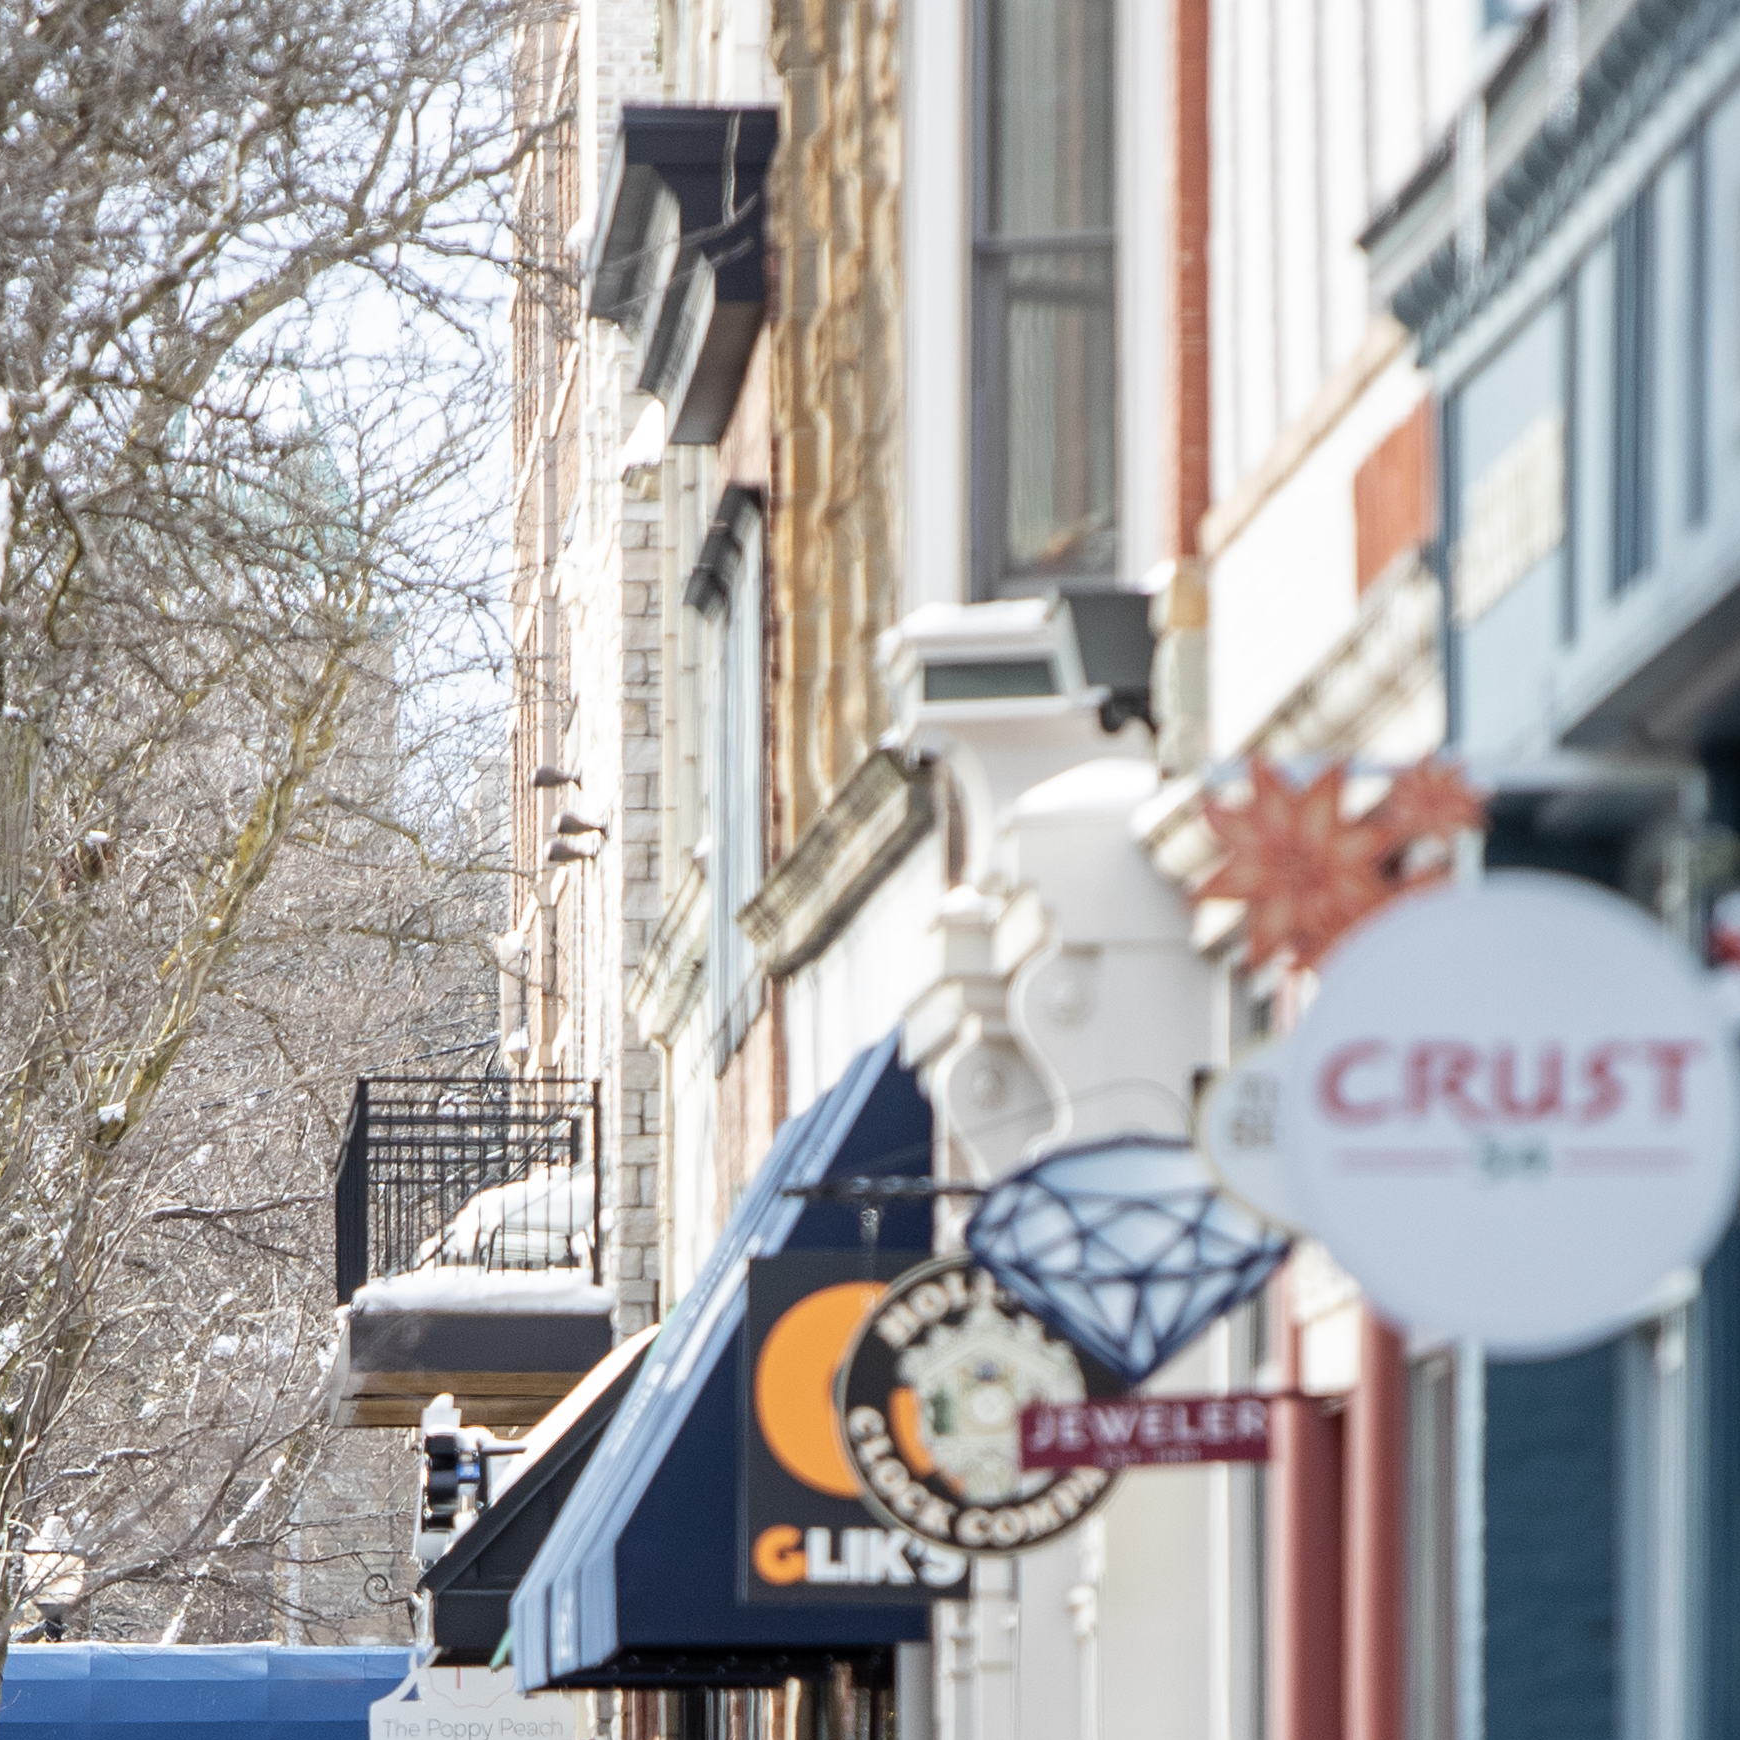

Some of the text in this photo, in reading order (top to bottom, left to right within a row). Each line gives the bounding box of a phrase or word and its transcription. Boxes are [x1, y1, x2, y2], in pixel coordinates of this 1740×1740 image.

[1316, 1037, 1708, 1130] CRUST
[846, 1405, 958, 1538] CLOCK
[752, 1523, 967, 1587] GLIK'S
[382, 1720, 421, 1738] The
[500, 1716, 564, 1738] Peach
